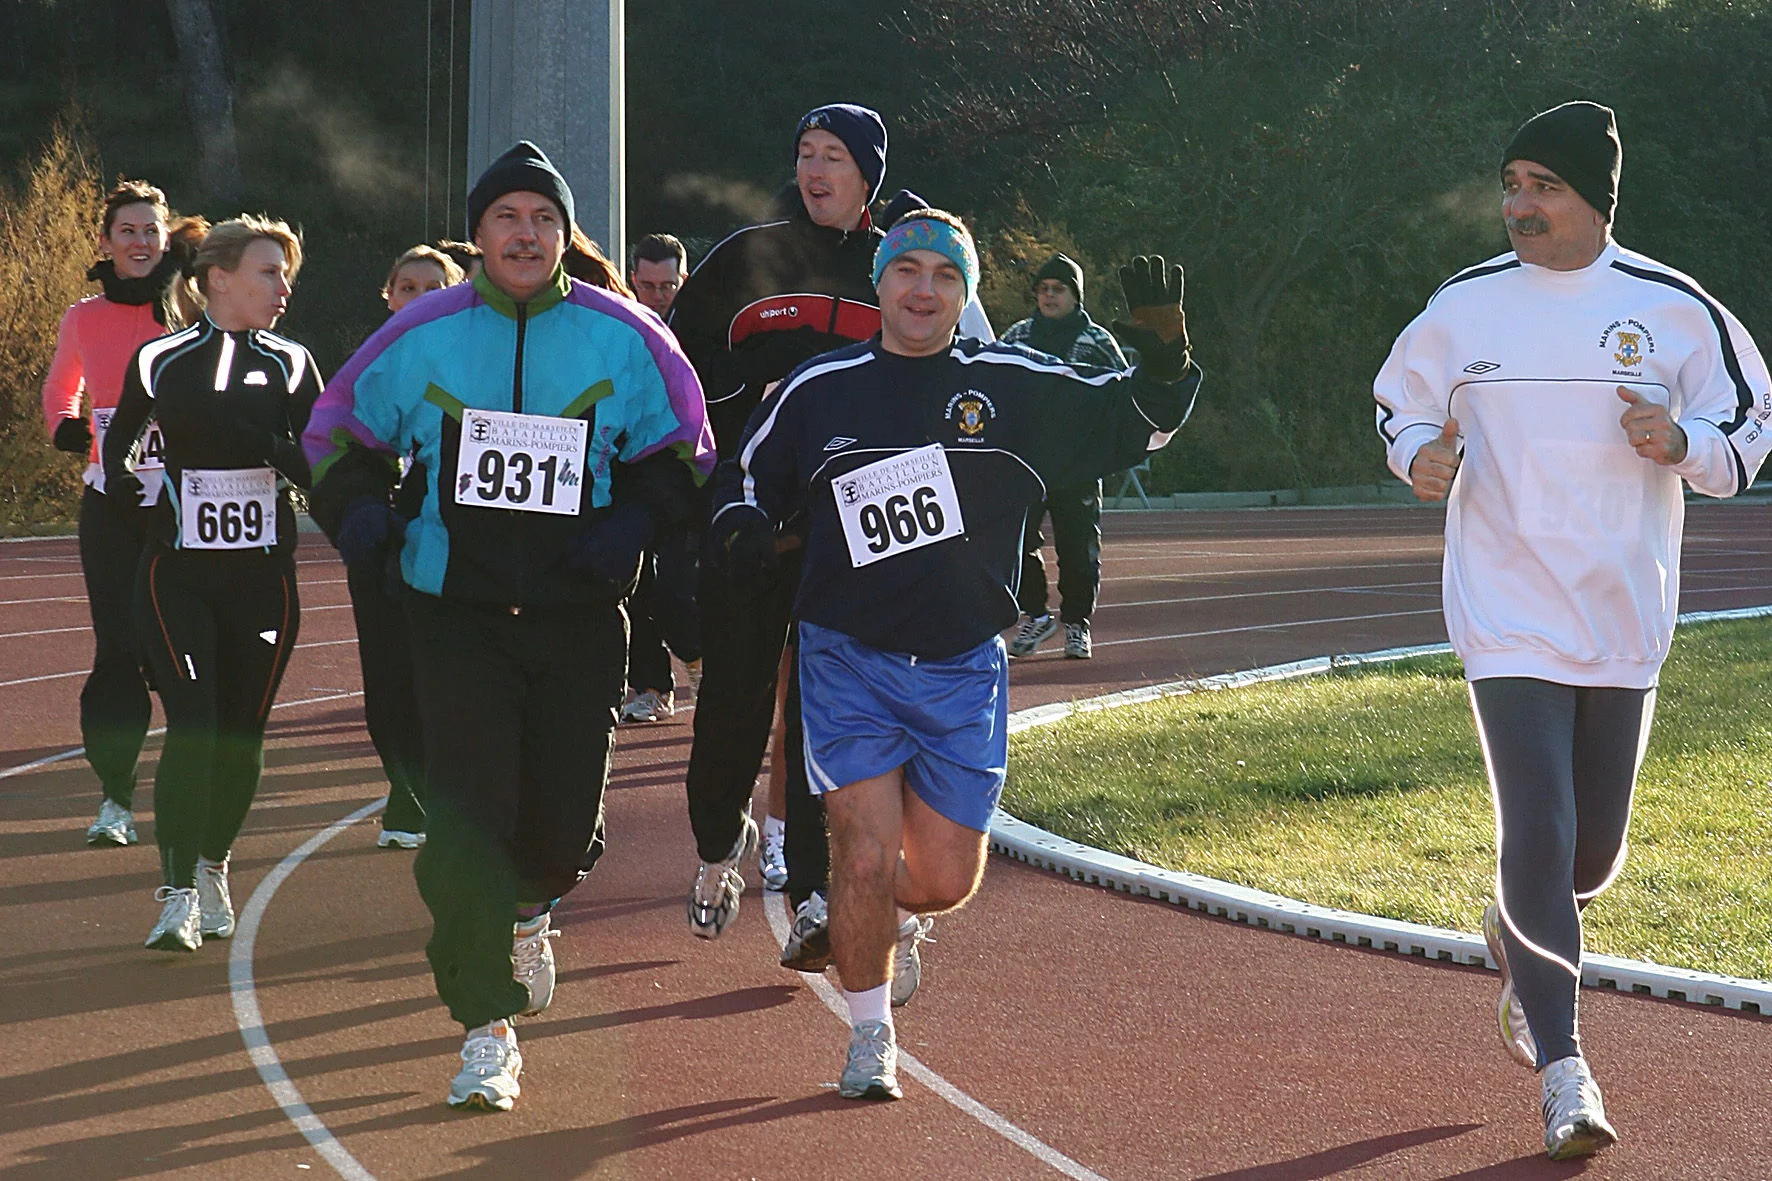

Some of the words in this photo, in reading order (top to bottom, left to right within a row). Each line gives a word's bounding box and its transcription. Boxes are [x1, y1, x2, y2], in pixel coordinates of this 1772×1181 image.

[492, 427, 578, 443] BATAILLON
[493, 419, 517, 428] VILLE
[491, 437, 578, 453] MARINS-POMPIERS
[477, 449, 557, 506] 931
[856, 470, 878, 482] VILLE
[880, 467, 889, 476] DE
[892, 452, 936, 470] MARSEILLE
[860, 460, 940, 491] BATAILLON
[861, 470, 943, 500] MARINS-POMPIERS
[197, 500, 263, 543] 669
[860, 486, 945, 554] 966
